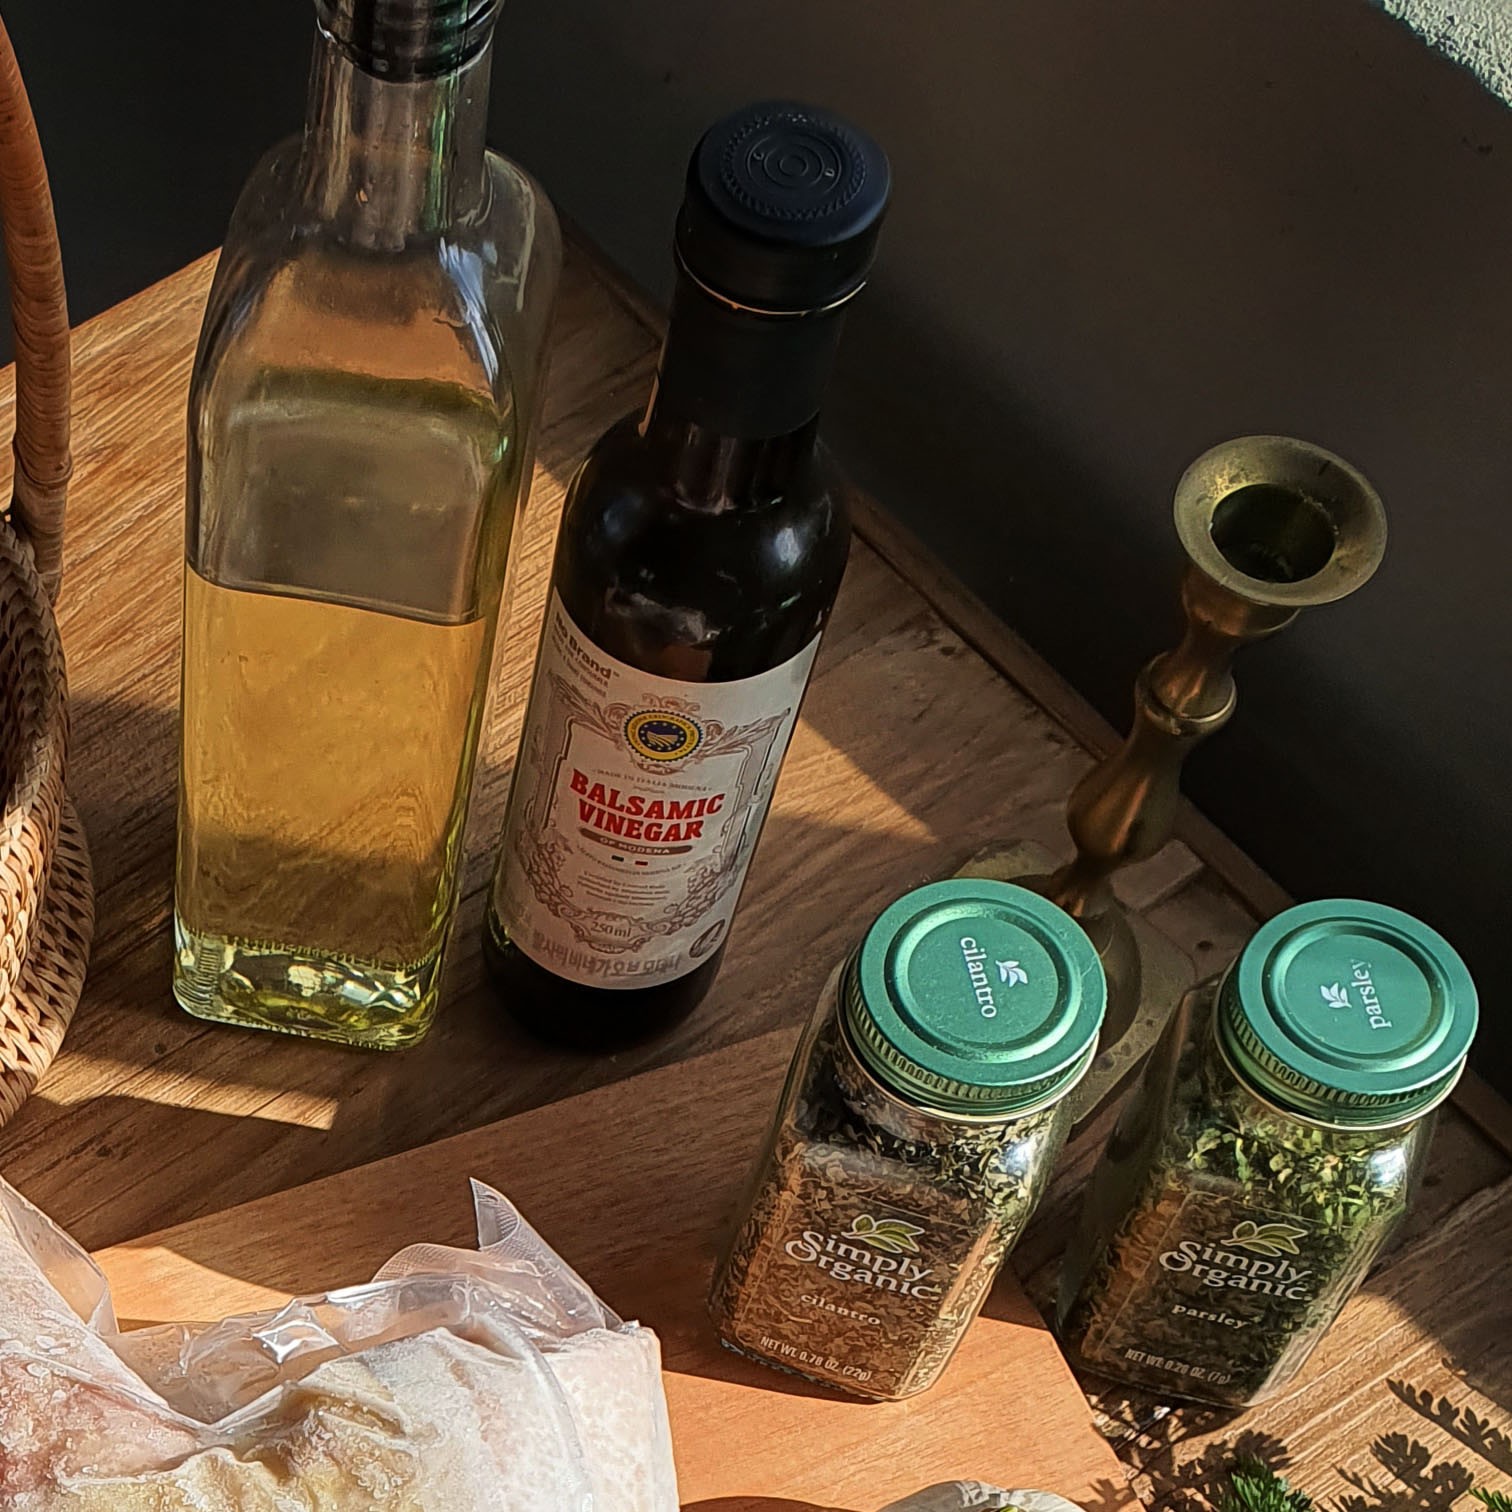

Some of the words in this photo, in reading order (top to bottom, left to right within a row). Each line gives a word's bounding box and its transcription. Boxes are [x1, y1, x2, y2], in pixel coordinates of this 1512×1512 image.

[569, 635, 612, 679] Brand
[569, 768, 726, 820] BALSAMIC
[579, 799, 704, 842] VINEGAR
[600, 837, 616, 847] OF
[618, 842, 670, 854] MODENA
[960, 937, 997, 1018] cilantro
[1350, 959, 1392, 1029] parsley
[785, 1240, 942, 1300] Organic
[803, 1231, 934, 1282] Simply
[1179, 1241, 1313, 1284] Simply
[800, 1294, 881, 1325] cilantro
[1171, 1304, 1250, 1329] parsley
[760, 1336, 780, 1351] NET
[1125, 1348, 1146, 1362] NET
